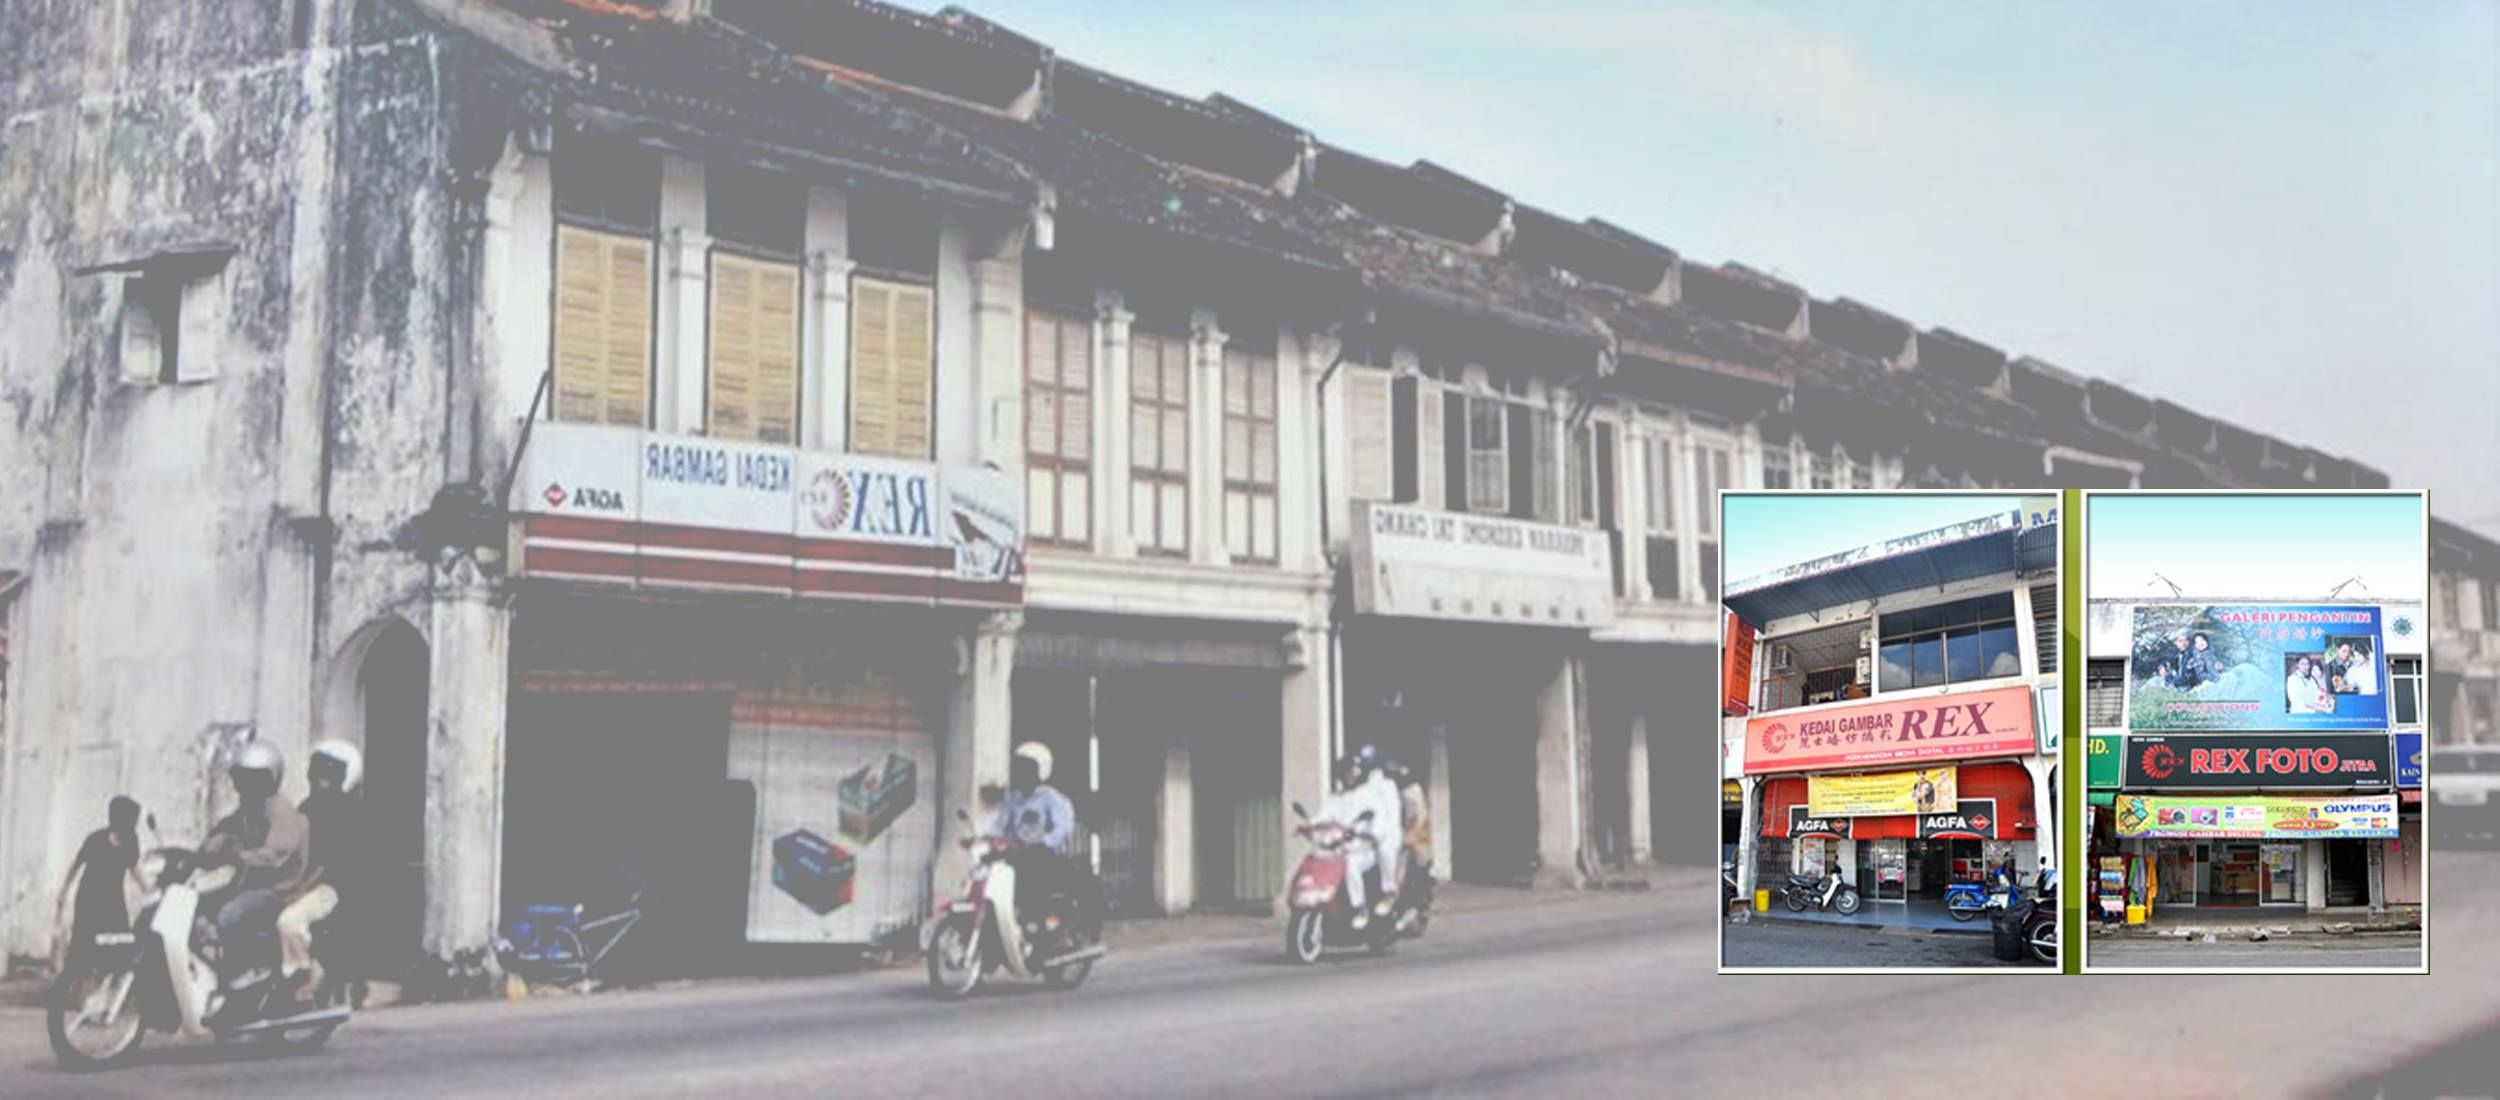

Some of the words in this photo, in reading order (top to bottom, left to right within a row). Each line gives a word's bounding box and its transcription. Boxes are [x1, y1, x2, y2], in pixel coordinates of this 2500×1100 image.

[2221, 611, 2276, 623] GALERI
[2279, 611, 2371, 623] PENGANTIN
[1800, 720, 1835, 736] KEDAI
[1839, 713, 1893, 733] GAMBAR
[1898, 701, 1994, 742] REX
[2191, 748, 2250, 774] REX
[2256, 747, 2338, 774] FOTO
[2324, 804, 2391, 813] OLYMPUS
[1796, 819, 1829, 832] AGFA
[1926, 815, 1967, 829] AGFA
